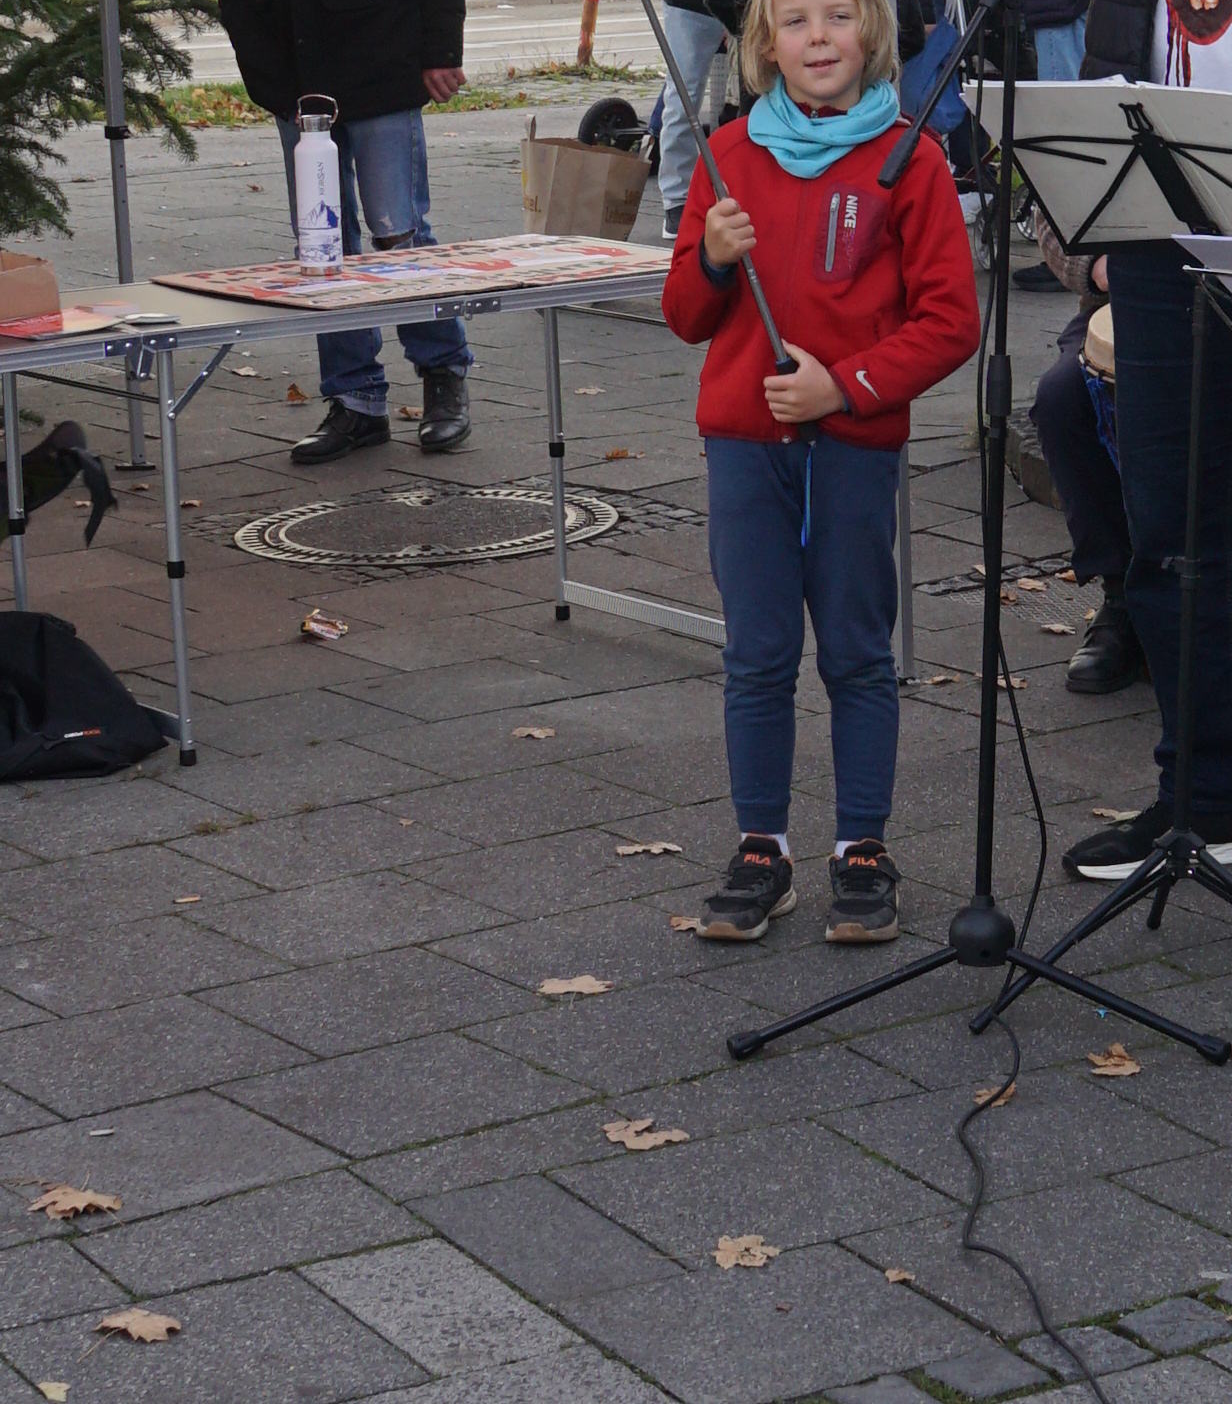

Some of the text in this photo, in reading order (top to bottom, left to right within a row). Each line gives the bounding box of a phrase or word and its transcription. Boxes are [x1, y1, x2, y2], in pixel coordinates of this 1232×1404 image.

[844, 194, 858, 228] NIKE
[744, 852, 772, 866] FILA
[848, 856, 878, 867] FILA
